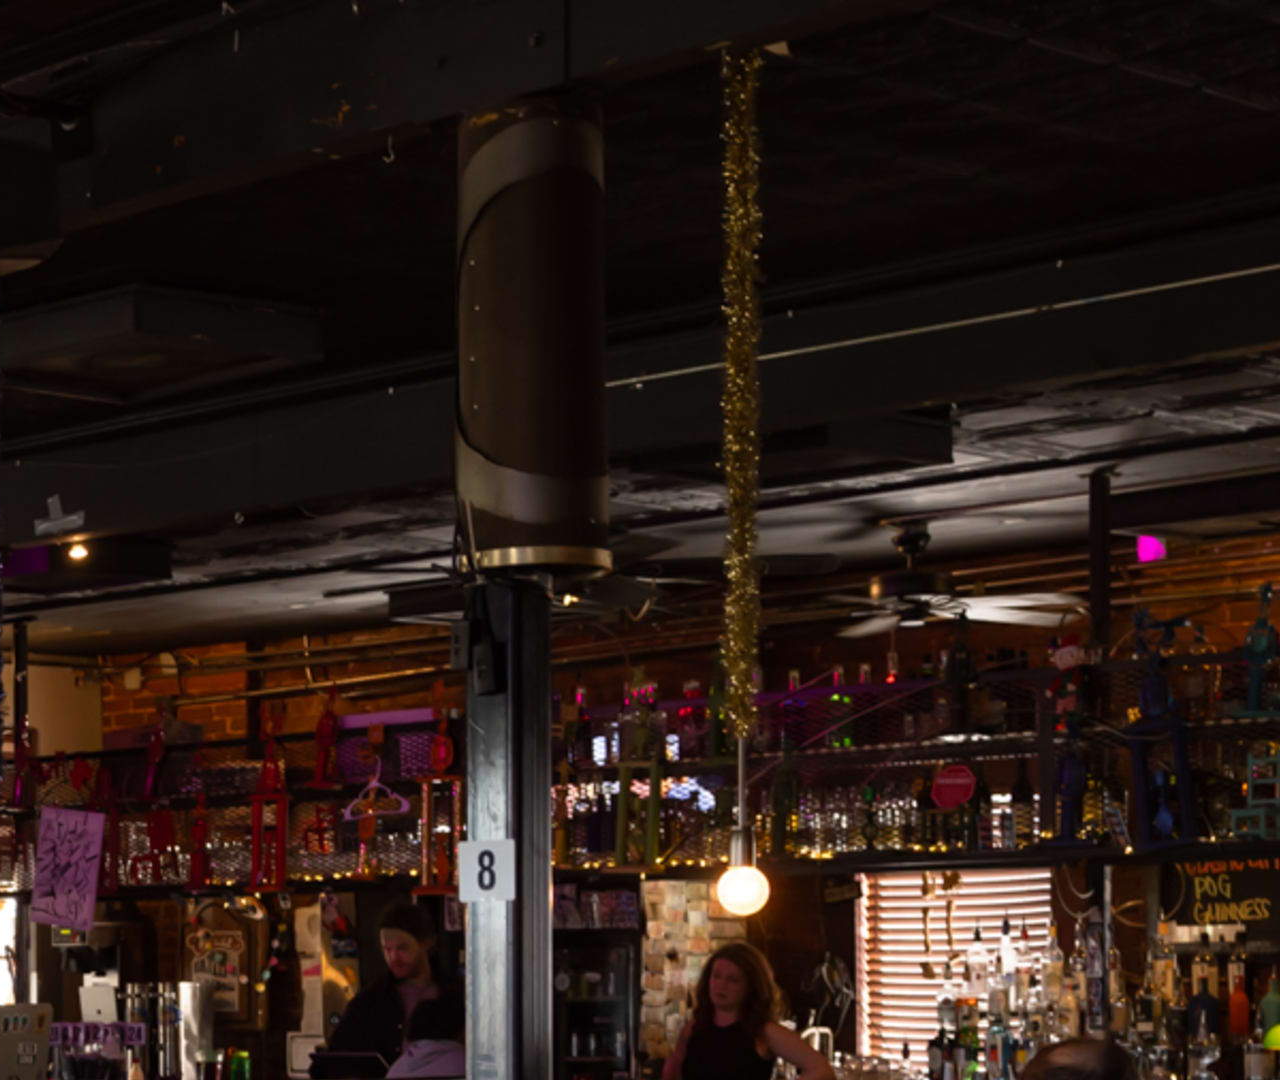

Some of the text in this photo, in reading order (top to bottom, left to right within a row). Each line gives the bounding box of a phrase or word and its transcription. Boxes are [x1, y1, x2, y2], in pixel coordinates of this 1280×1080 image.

[477, 849, 496, 890] 8
[1193, 873, 1231, 900] POG
[1193, 896, 1271, 925] GUINNESS
